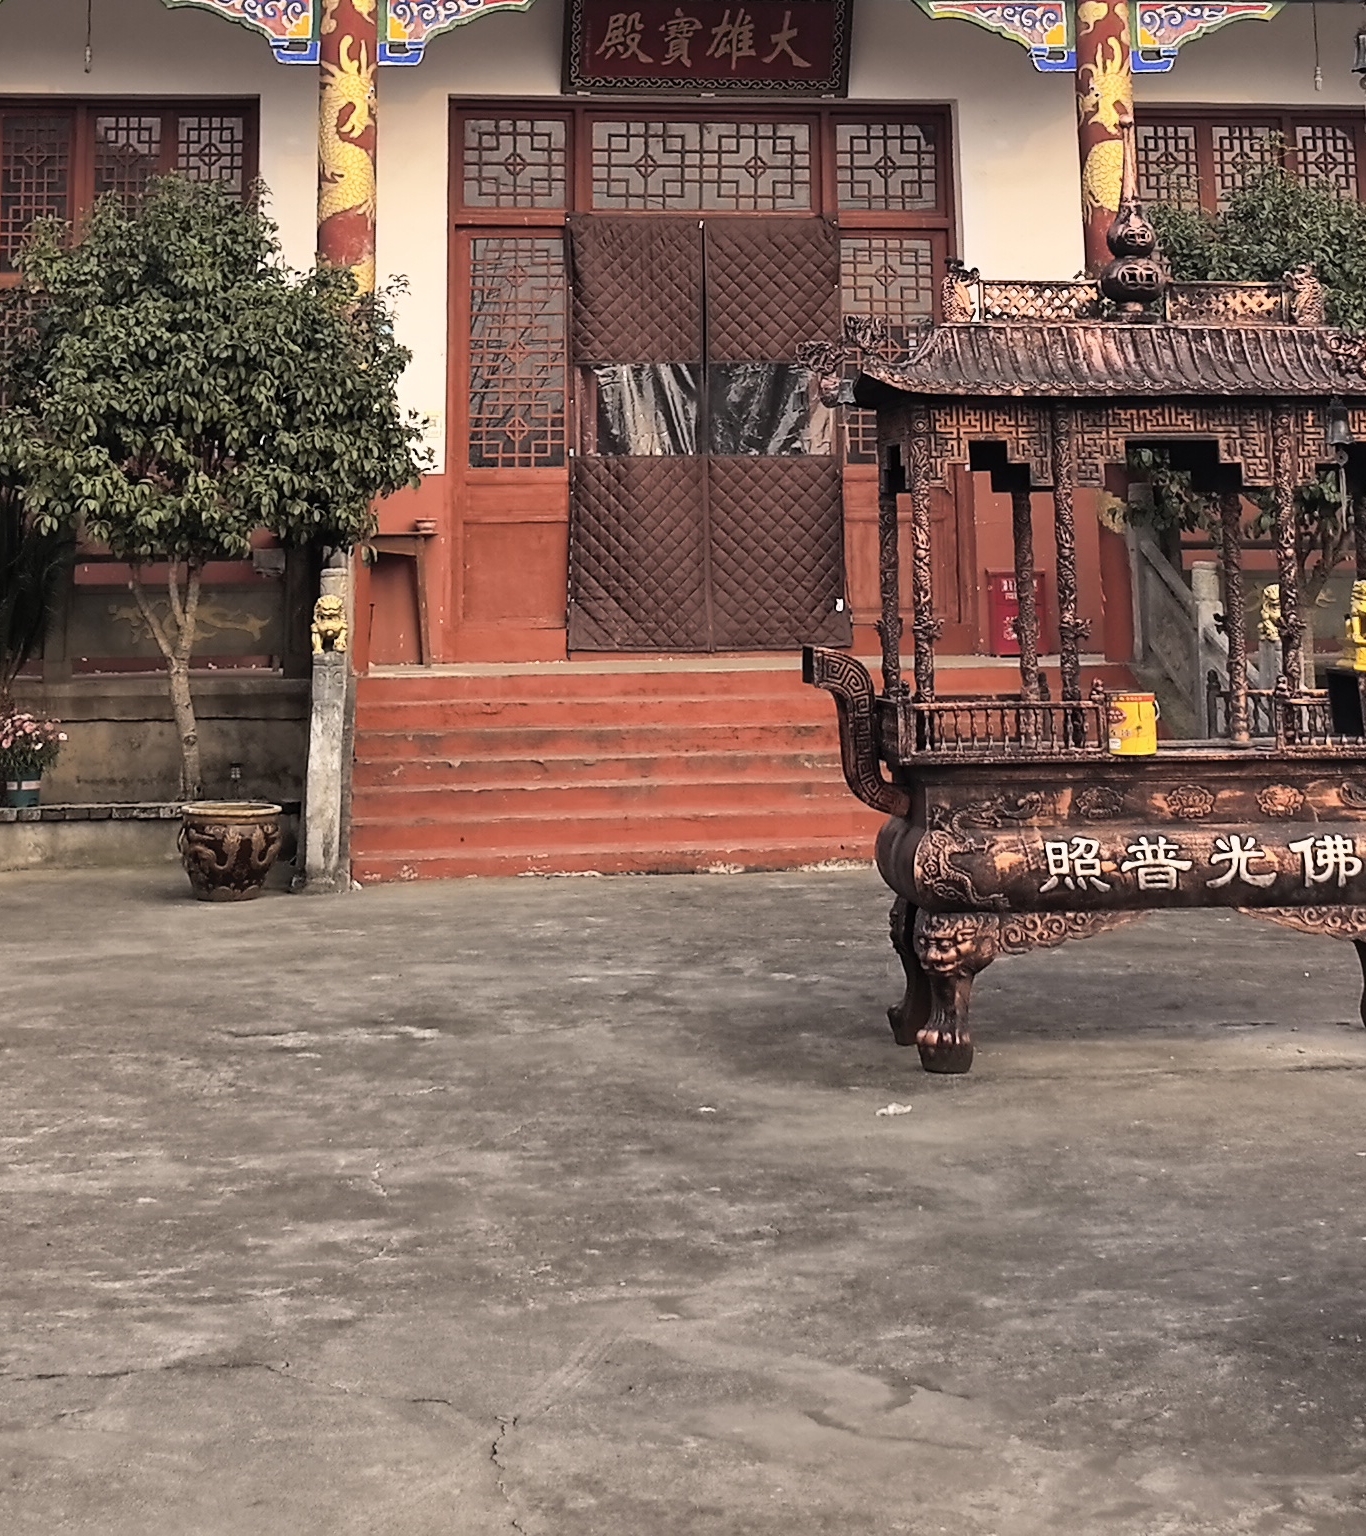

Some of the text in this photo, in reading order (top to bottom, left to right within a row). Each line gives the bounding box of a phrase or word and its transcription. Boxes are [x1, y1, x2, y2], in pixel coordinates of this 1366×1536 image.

[595, 7, 812, 70] 大雄寶殿
[1039, 834, 1363, 893] 佛光普照
